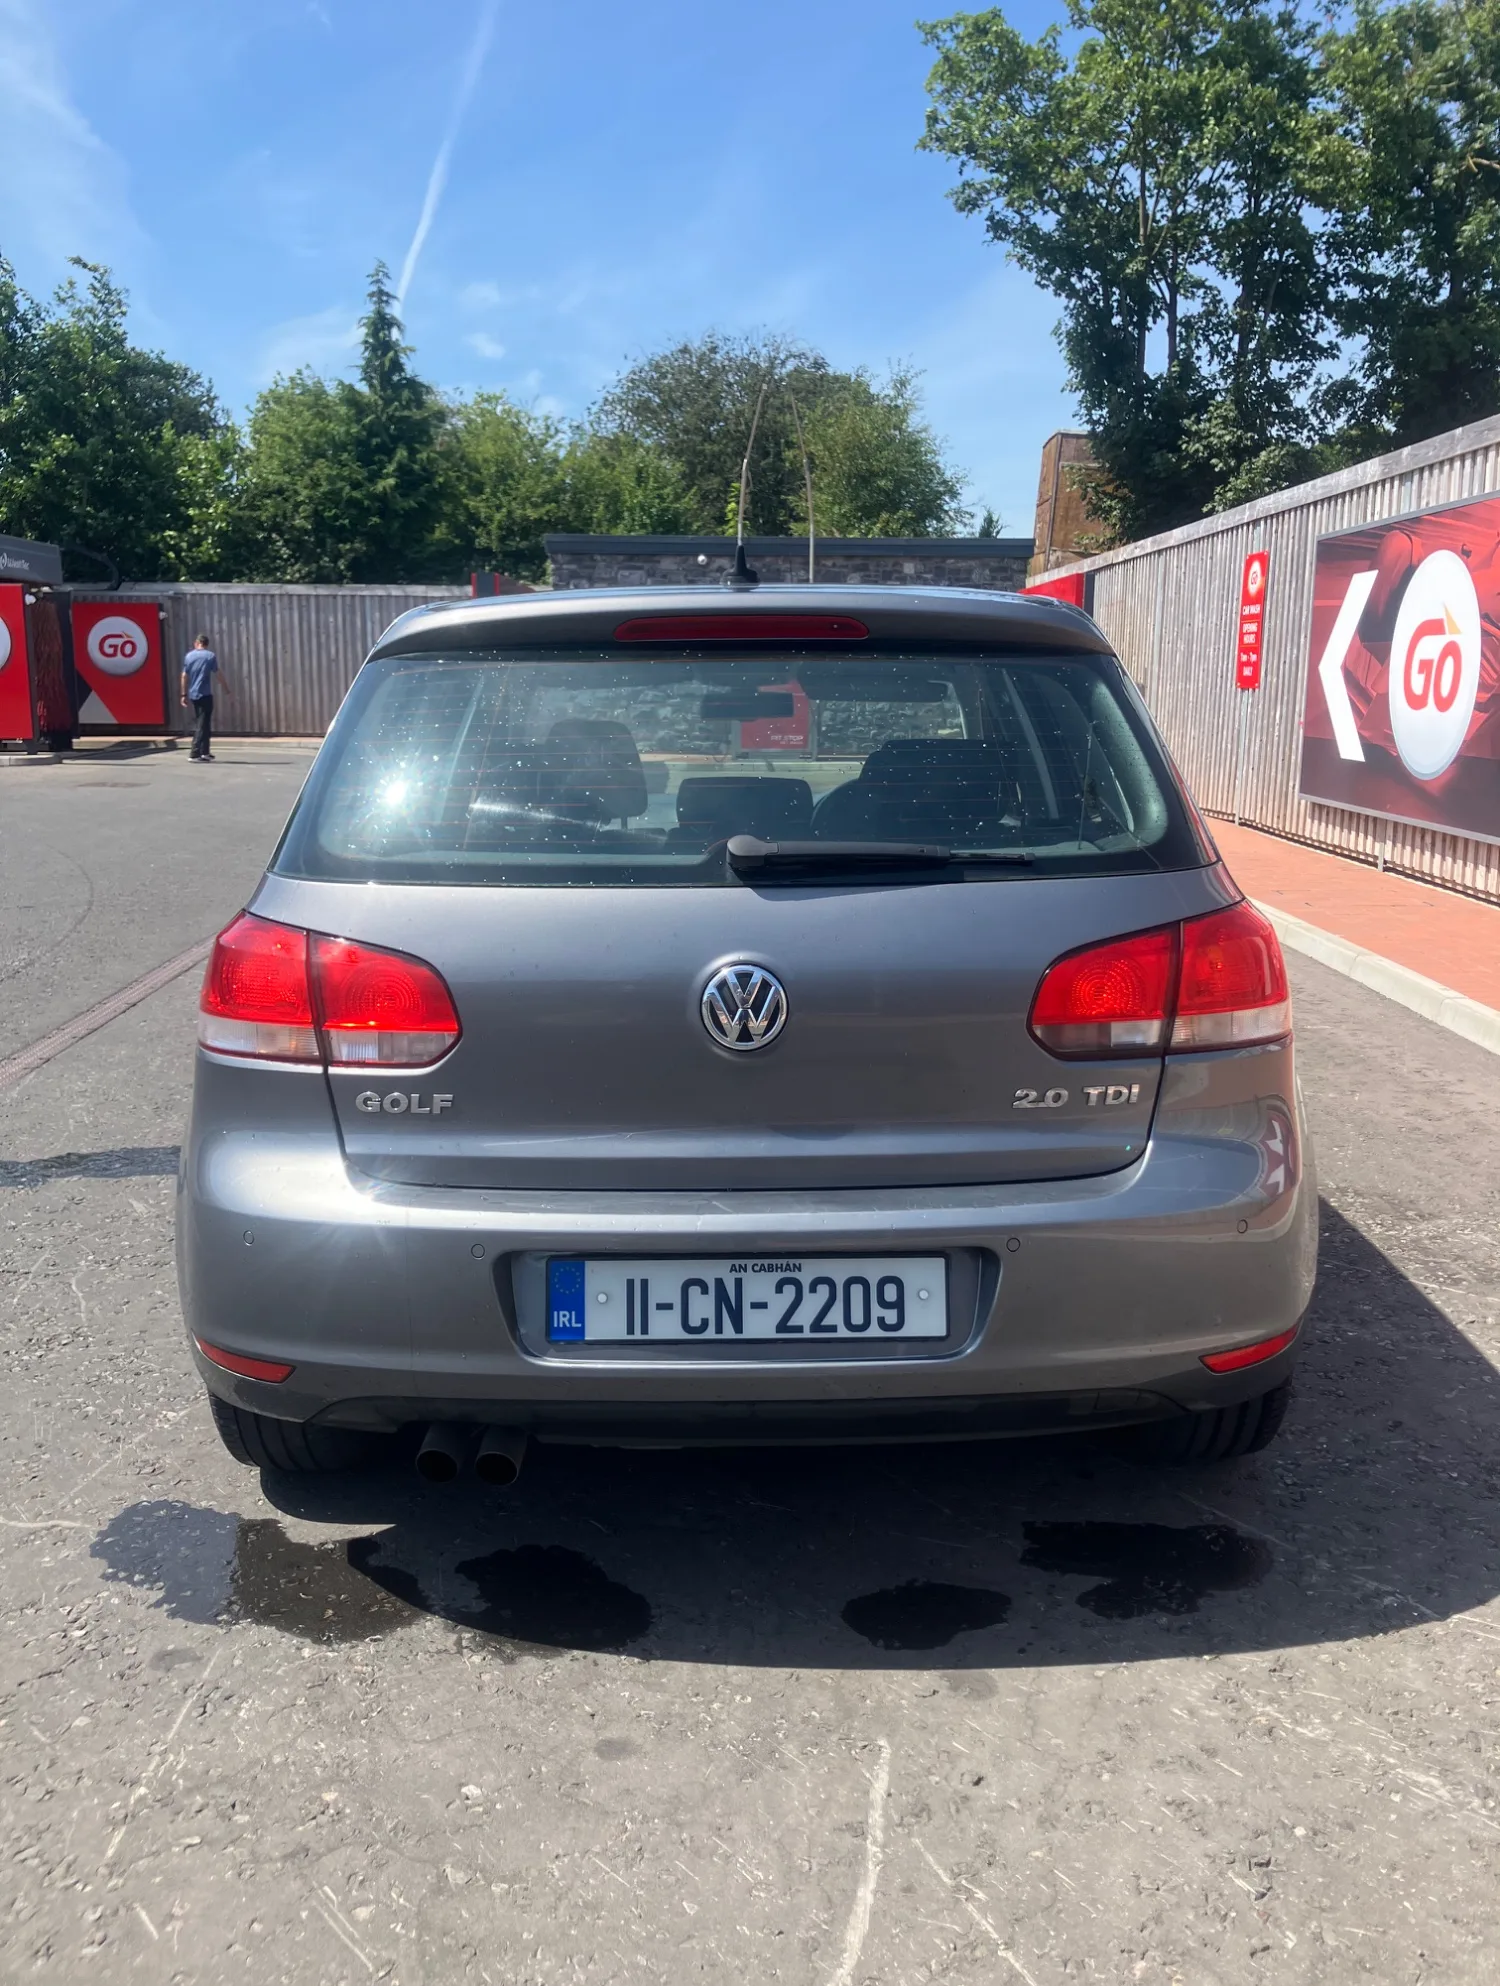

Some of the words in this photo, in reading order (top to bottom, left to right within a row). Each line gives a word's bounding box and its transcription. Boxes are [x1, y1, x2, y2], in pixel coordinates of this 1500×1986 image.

[1242, 622, 1258, 633] OPENING
[1243, 633, 1256, 644] HOURS
[702, 965, 788, 1050] VW
[355, 1090, 454, 1115] GOLF
[1083, 1084, 1140, 1107] TDI
[729, 1263, 748, 1274] AN
[751, 1262, 803, 1273] CABHÁN
[625, 1275, 906, 1336] 11-CN-2209
[553, 1310, 582, 1328] IRL
